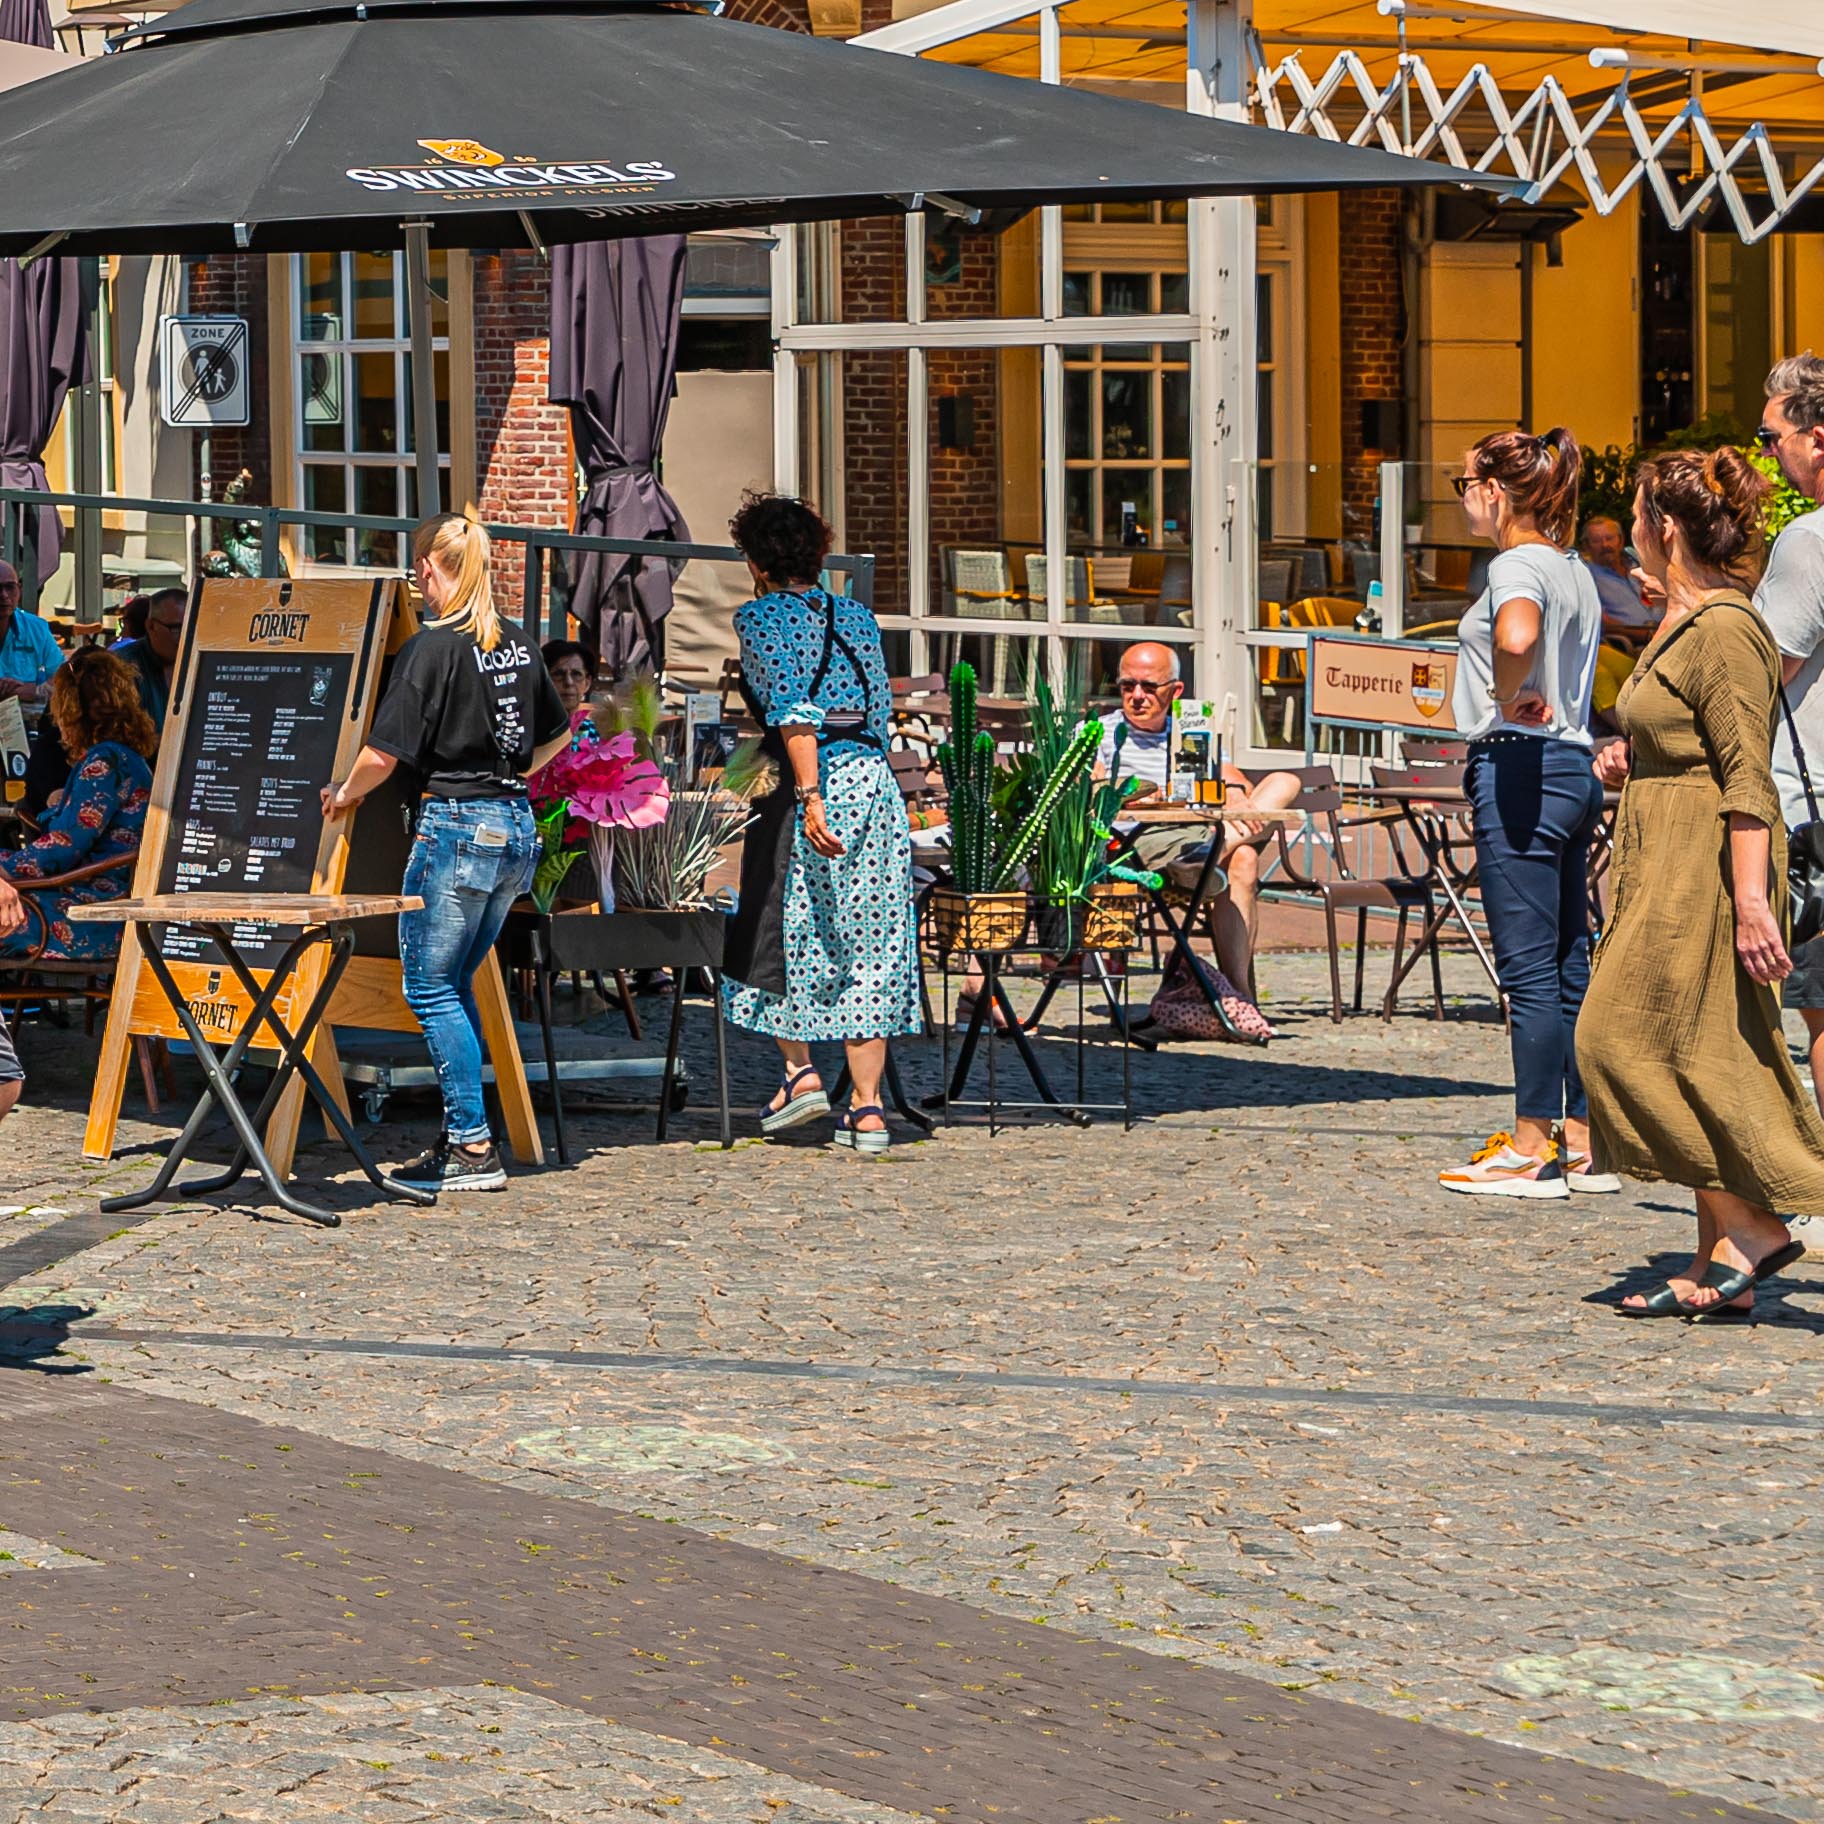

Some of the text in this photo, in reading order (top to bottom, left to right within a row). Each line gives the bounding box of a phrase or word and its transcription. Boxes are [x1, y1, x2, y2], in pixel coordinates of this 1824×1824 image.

[346, 161, 675, 190] SWINCKELS'
[442, 187, 656, 201] SUPERIOR PILSNER
[191, 328, 225, 338] ZONE
[249, 614, 310, 642] CORNET
[1326, 666, 1403, 694] Tapperie
